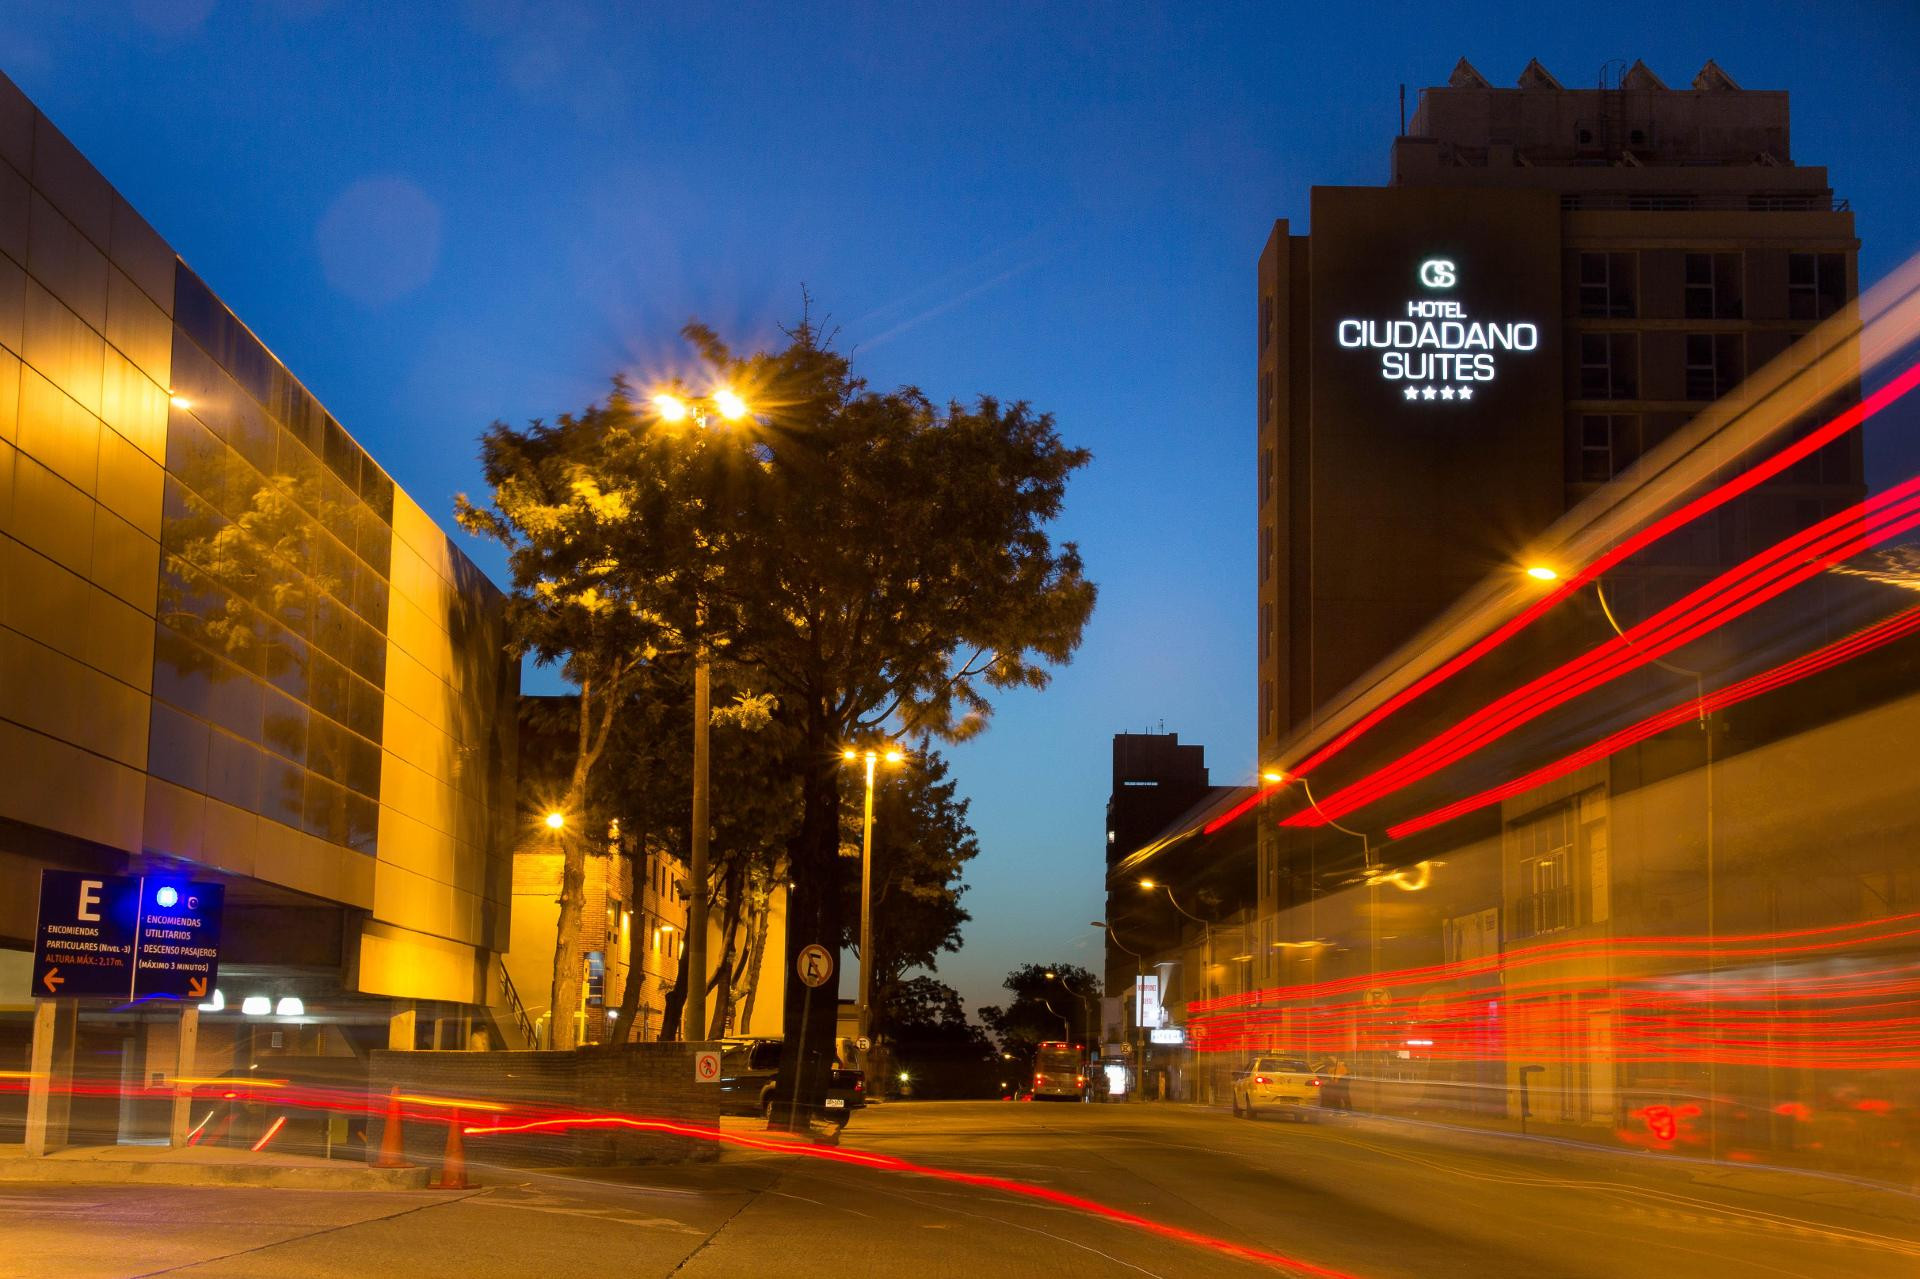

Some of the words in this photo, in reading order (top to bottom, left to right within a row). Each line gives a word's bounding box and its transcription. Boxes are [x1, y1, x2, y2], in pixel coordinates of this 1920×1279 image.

[1409, 302, 1467, 318] HOTEL
[1339, 320, 1537, 350] CIUDADANO
[1382, 352, 1495, 381] SUITES
[78, 880, 103, 921] E
[147, 915, 201, 927] ENCOMIENDAS
[48, 925, 99, 936] ENCOMIENDAS
[145, 929, 191, 940] UTILITARIOS
[47, 940, 97, 951] PARTICULARES
[144, 946, 180, 956] DESCENSO
[180, 947, 216, 958] PASAJEROS
[46, 955, 75, 965] ALTURA
[171, 961, 175, 970] 3
[177, 963, 209, 972] MINUTOS)
